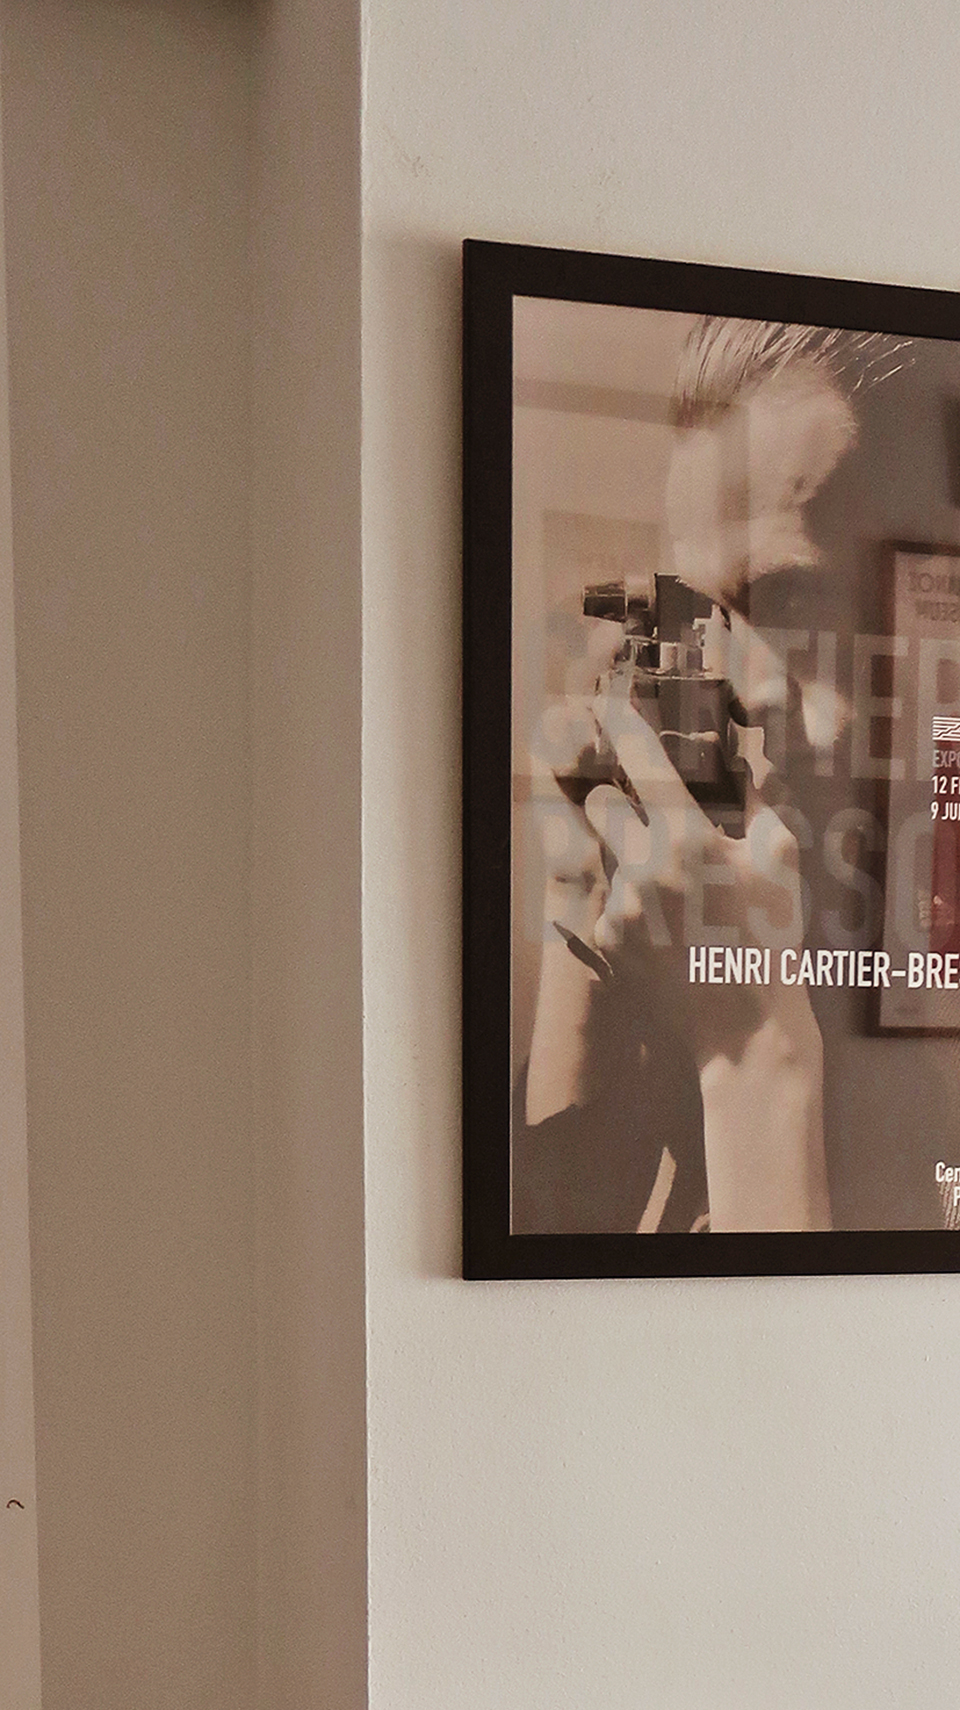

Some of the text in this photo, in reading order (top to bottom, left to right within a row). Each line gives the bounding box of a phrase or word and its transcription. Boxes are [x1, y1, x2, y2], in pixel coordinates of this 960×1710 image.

[931, 775, 948, 795] 12
[930, 801, 939, 820] 9
[689, 946, 771, 985] HENRI
